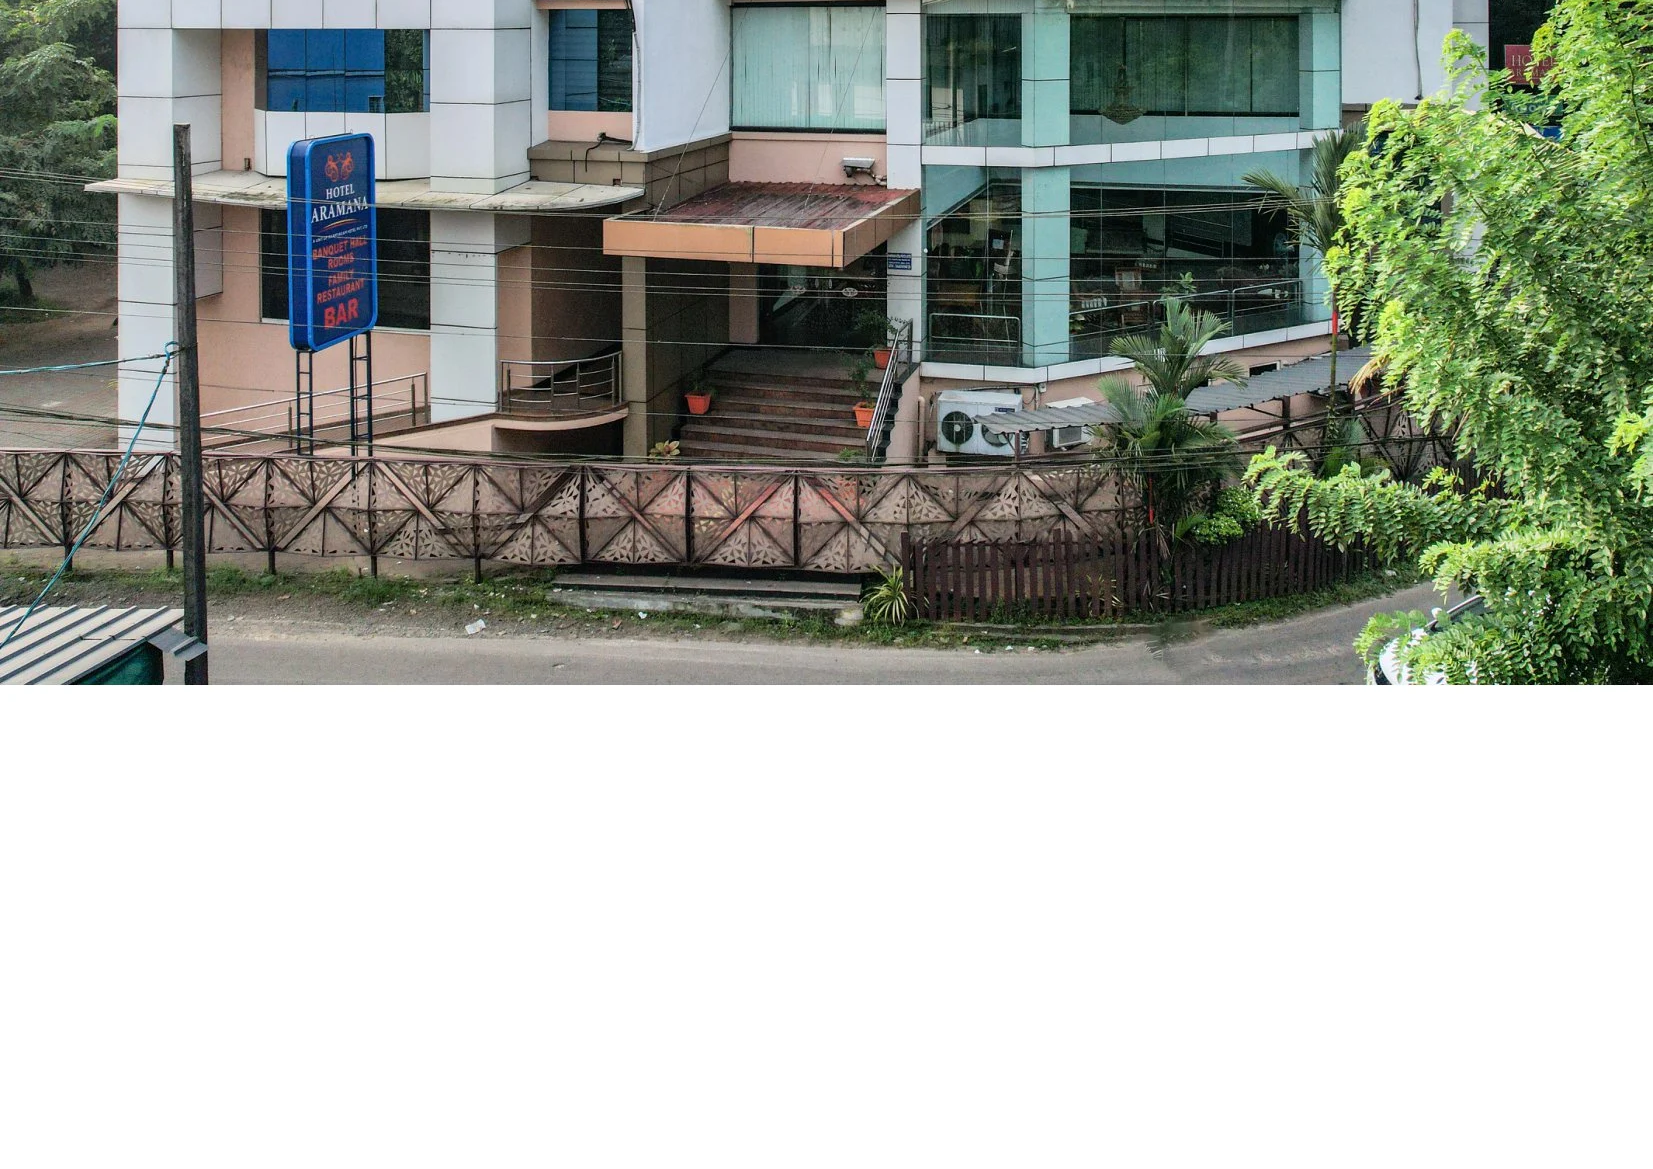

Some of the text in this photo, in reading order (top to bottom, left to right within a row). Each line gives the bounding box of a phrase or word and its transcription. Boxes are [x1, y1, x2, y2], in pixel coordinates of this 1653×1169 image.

[1511, 54, 1553, 67] HOEL
[325, 183, 355, 200] HOTEL
[311, 196, 368, 223] ARAMANA
[312, 240, 348, 260] BANQUET
[327, 252, 355, 269] ROOMS
[328, 268, 354, 287] FAMILY
[316, 277, 365, 304] RESTAURANT
[324, 297, 359, 330] BAR
